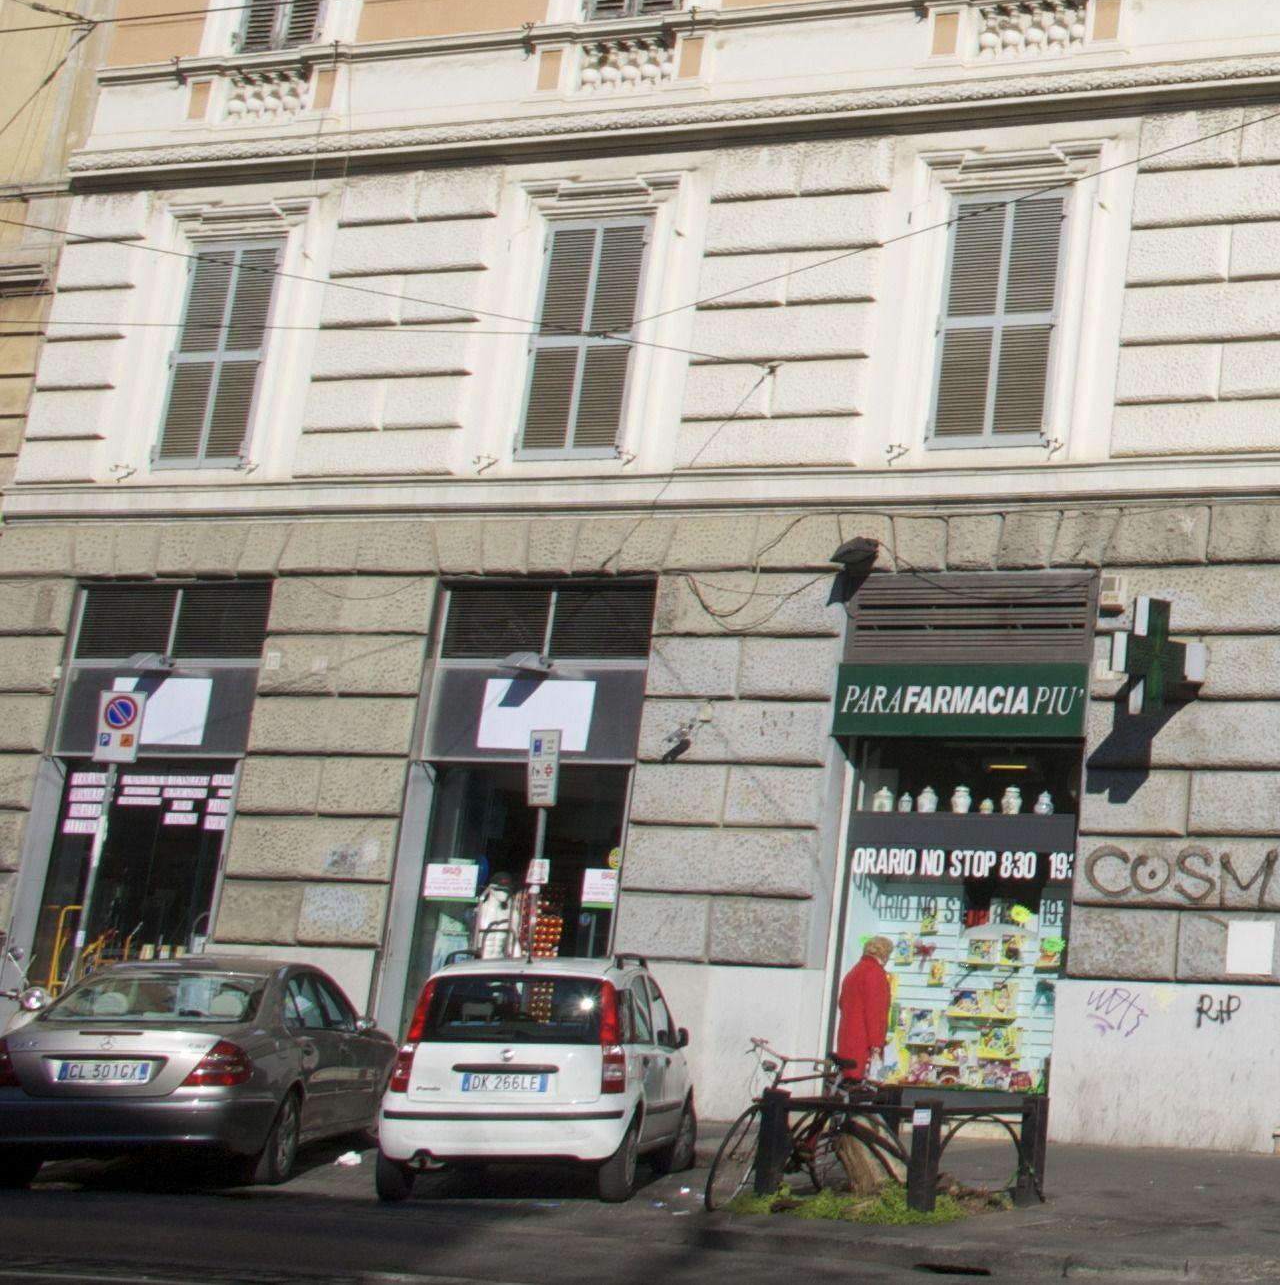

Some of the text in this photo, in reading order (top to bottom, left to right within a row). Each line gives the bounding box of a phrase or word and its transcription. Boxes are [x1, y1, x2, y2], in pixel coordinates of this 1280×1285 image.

[853, 847, 916, 875] ORARIO
[920, 849, 945, 876] NO
[949, 850, 996, 878] STOP
[69, 1064, 137, 1079] CL 301GX
[472, 1075, 490, 1089] DK
